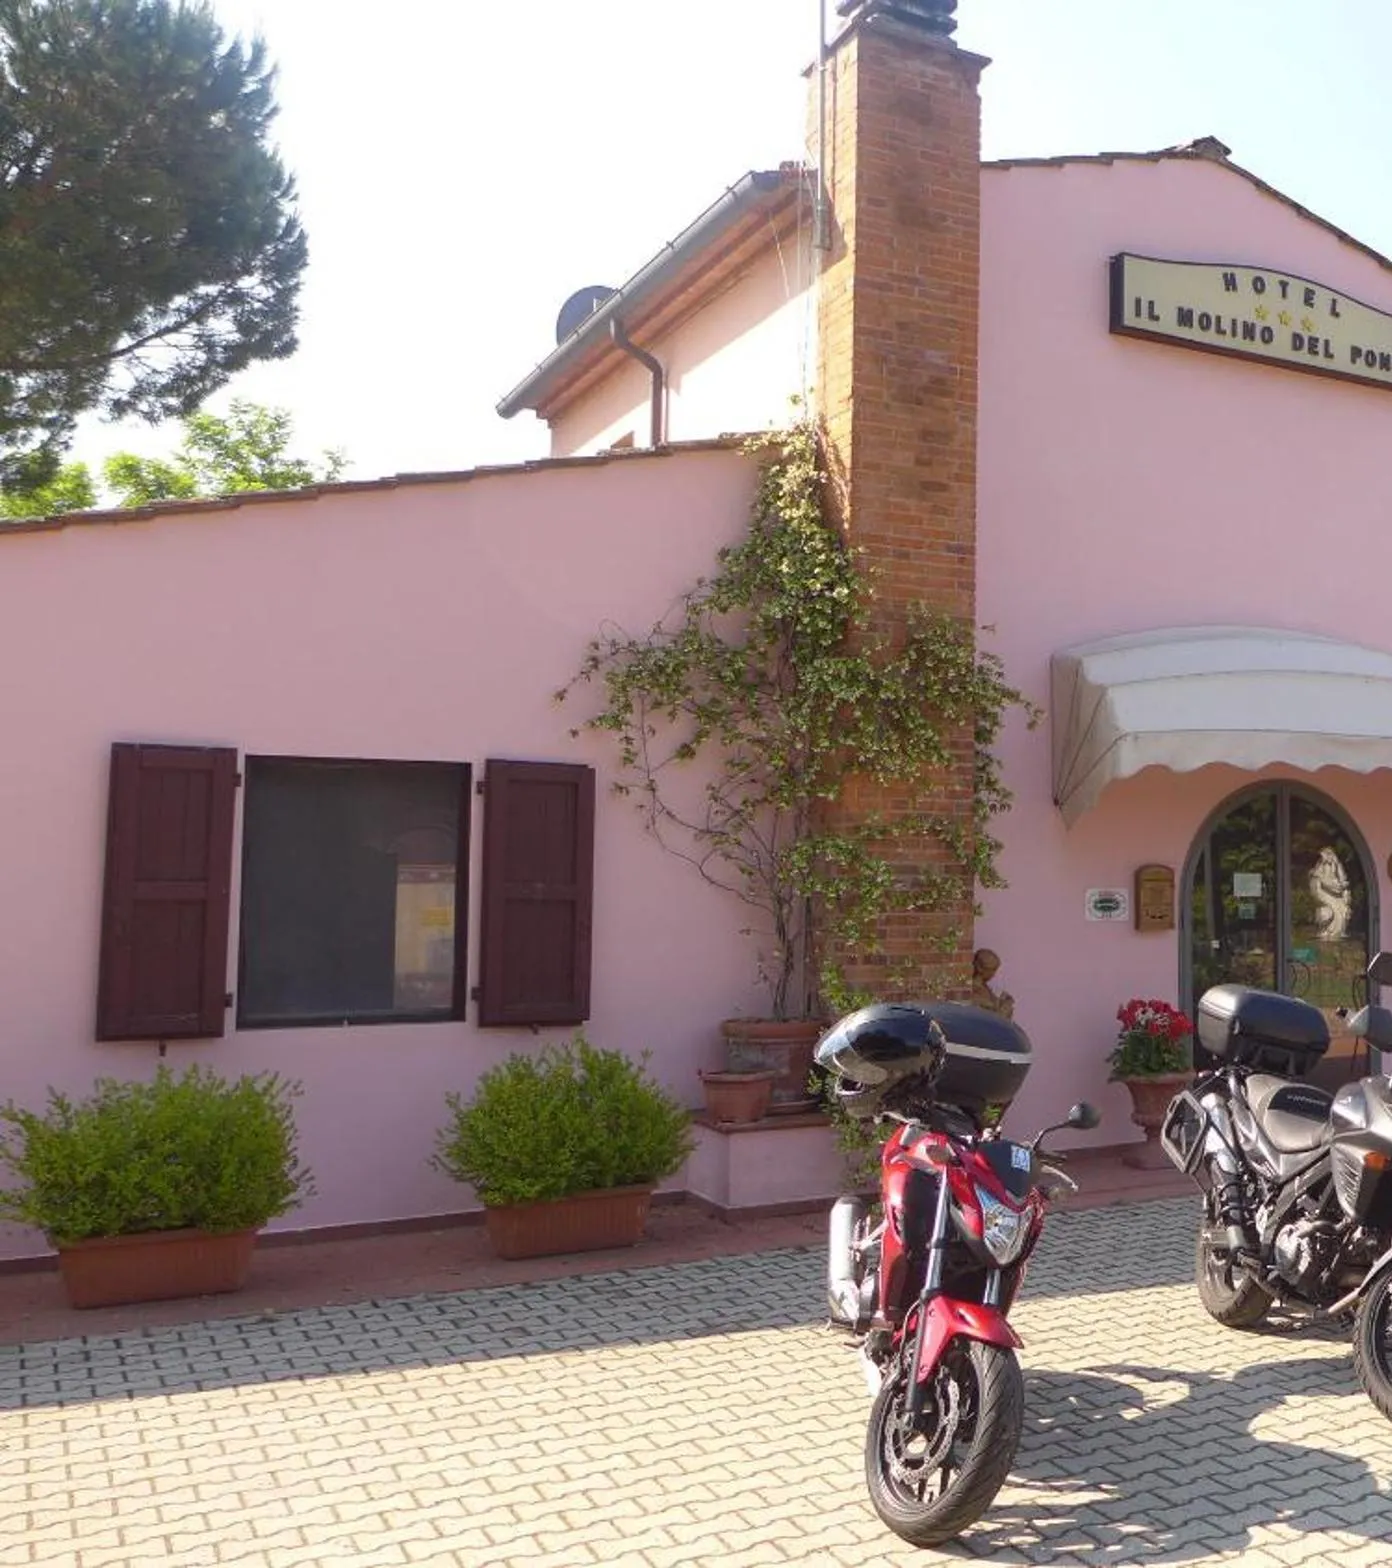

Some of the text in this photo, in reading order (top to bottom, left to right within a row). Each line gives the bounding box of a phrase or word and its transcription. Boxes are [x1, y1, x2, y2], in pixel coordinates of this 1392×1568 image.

[1222, 272, 1340, 318] HOTEL
[1135, 296, 1161, 322] IL
[1177, 306, 1274, 344] MOLINO
[1292, 331, 1335, 360] DEL
